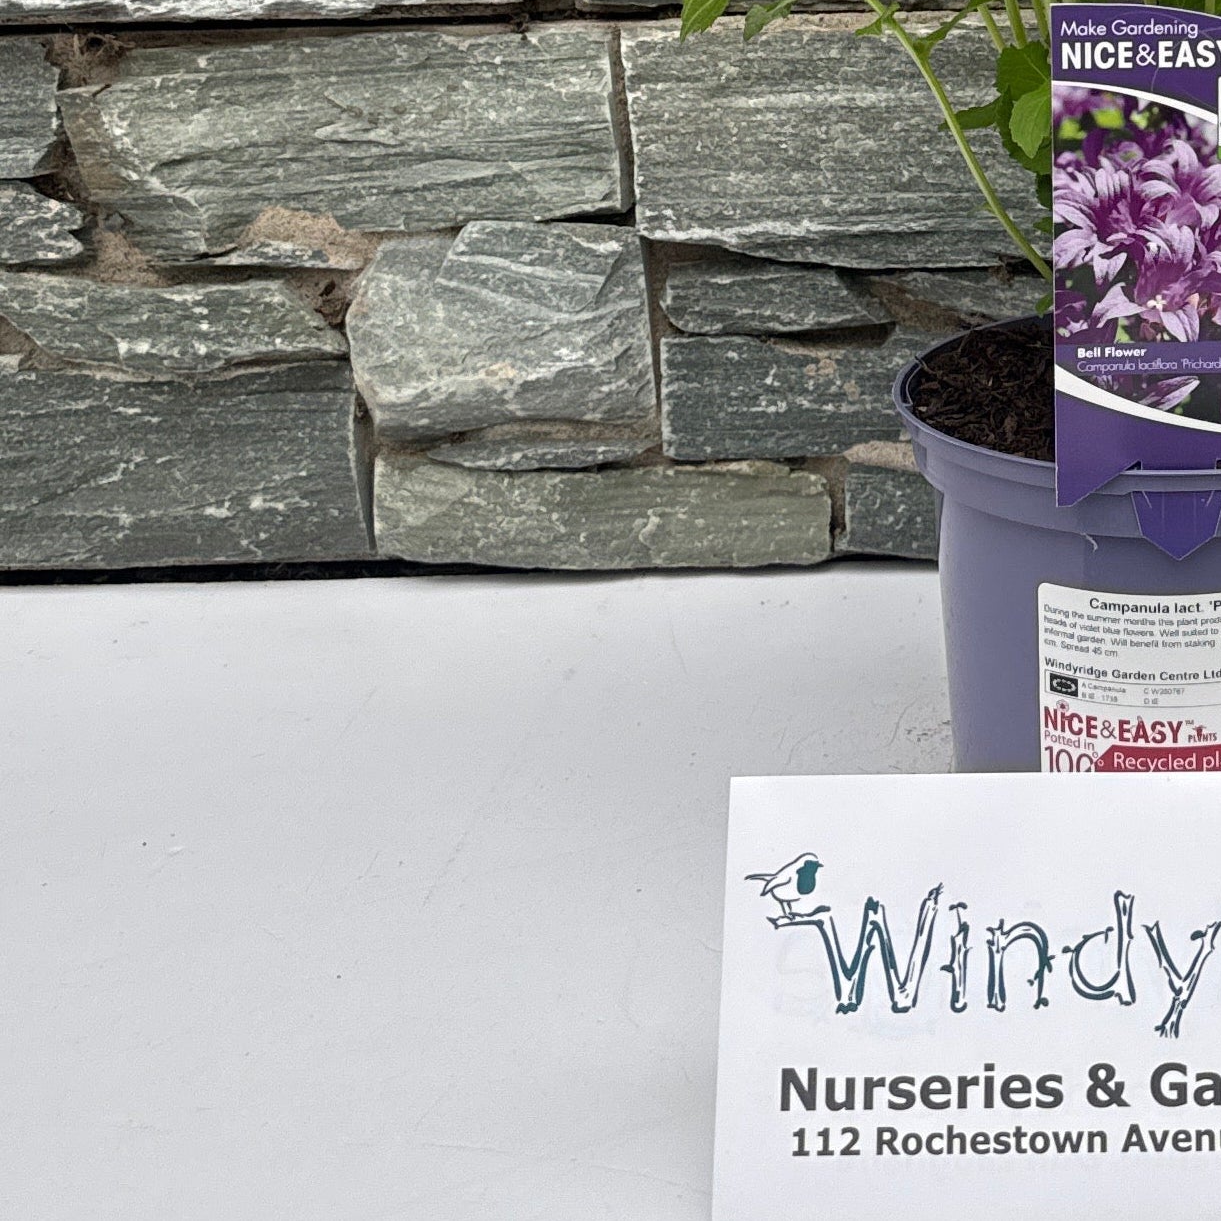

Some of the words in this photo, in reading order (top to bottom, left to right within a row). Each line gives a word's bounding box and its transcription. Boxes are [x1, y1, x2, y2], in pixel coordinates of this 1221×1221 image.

[1060, 19, 1107, 36] Make
[1111, 18, 1199, 39] Gardening
[1077, 347, 1101, 358] Bell
[1104, 347, 1147, 357] Flower
[1077, 359, 1136, 373] Campanula
[1138, 358, 1178, 370] lactiflora
[1043, 603, 1070, 618] During
[1071, 610, 1085, 620] the
[1086, 614, 1122, 624] summer
[1123, 618, 1156, 626] months
[1158, 618, 1174, 626] this
[1176, 617, 1198, 627] plant
[1089, 597, 1170, 615] Campanula
[1043, 615, 1068, 627] heads
[1102, 626, 1121, 634] blue
[1159, 629, 1180, 637] Well
[1182, 628, 1208, 637] suited
[1210, 627, 1219, 635] to
[1043, 626, 1075, 639] informal
[1110, 638, 1128, 646] Will
[1129, 639, 1159, 648] benefit
[1161, 640, 1182, 648] from
[1060, 640, 1090, 654] Spread
[1092, 646, 1102, 655] 45
[1044, 656, 1108, 678] Windyridge
[1112, 669, 1156, 681] Garden
[1160, 670, 1200, 681] Centre
[1087, 682, 1127, 693] Campanula
[1044, 730, 1080, 748] Potted
[1083, 740, 1096, 751] in
[1113, 751, 1197, 771] Recycled
[779, 1062, 1064, 1112] Nurseries
[1085, 1062, 1131, 1109] &
[791, 1126, 861, 1157] 112
[875, 1124, 1108, 1156] Rochestown
